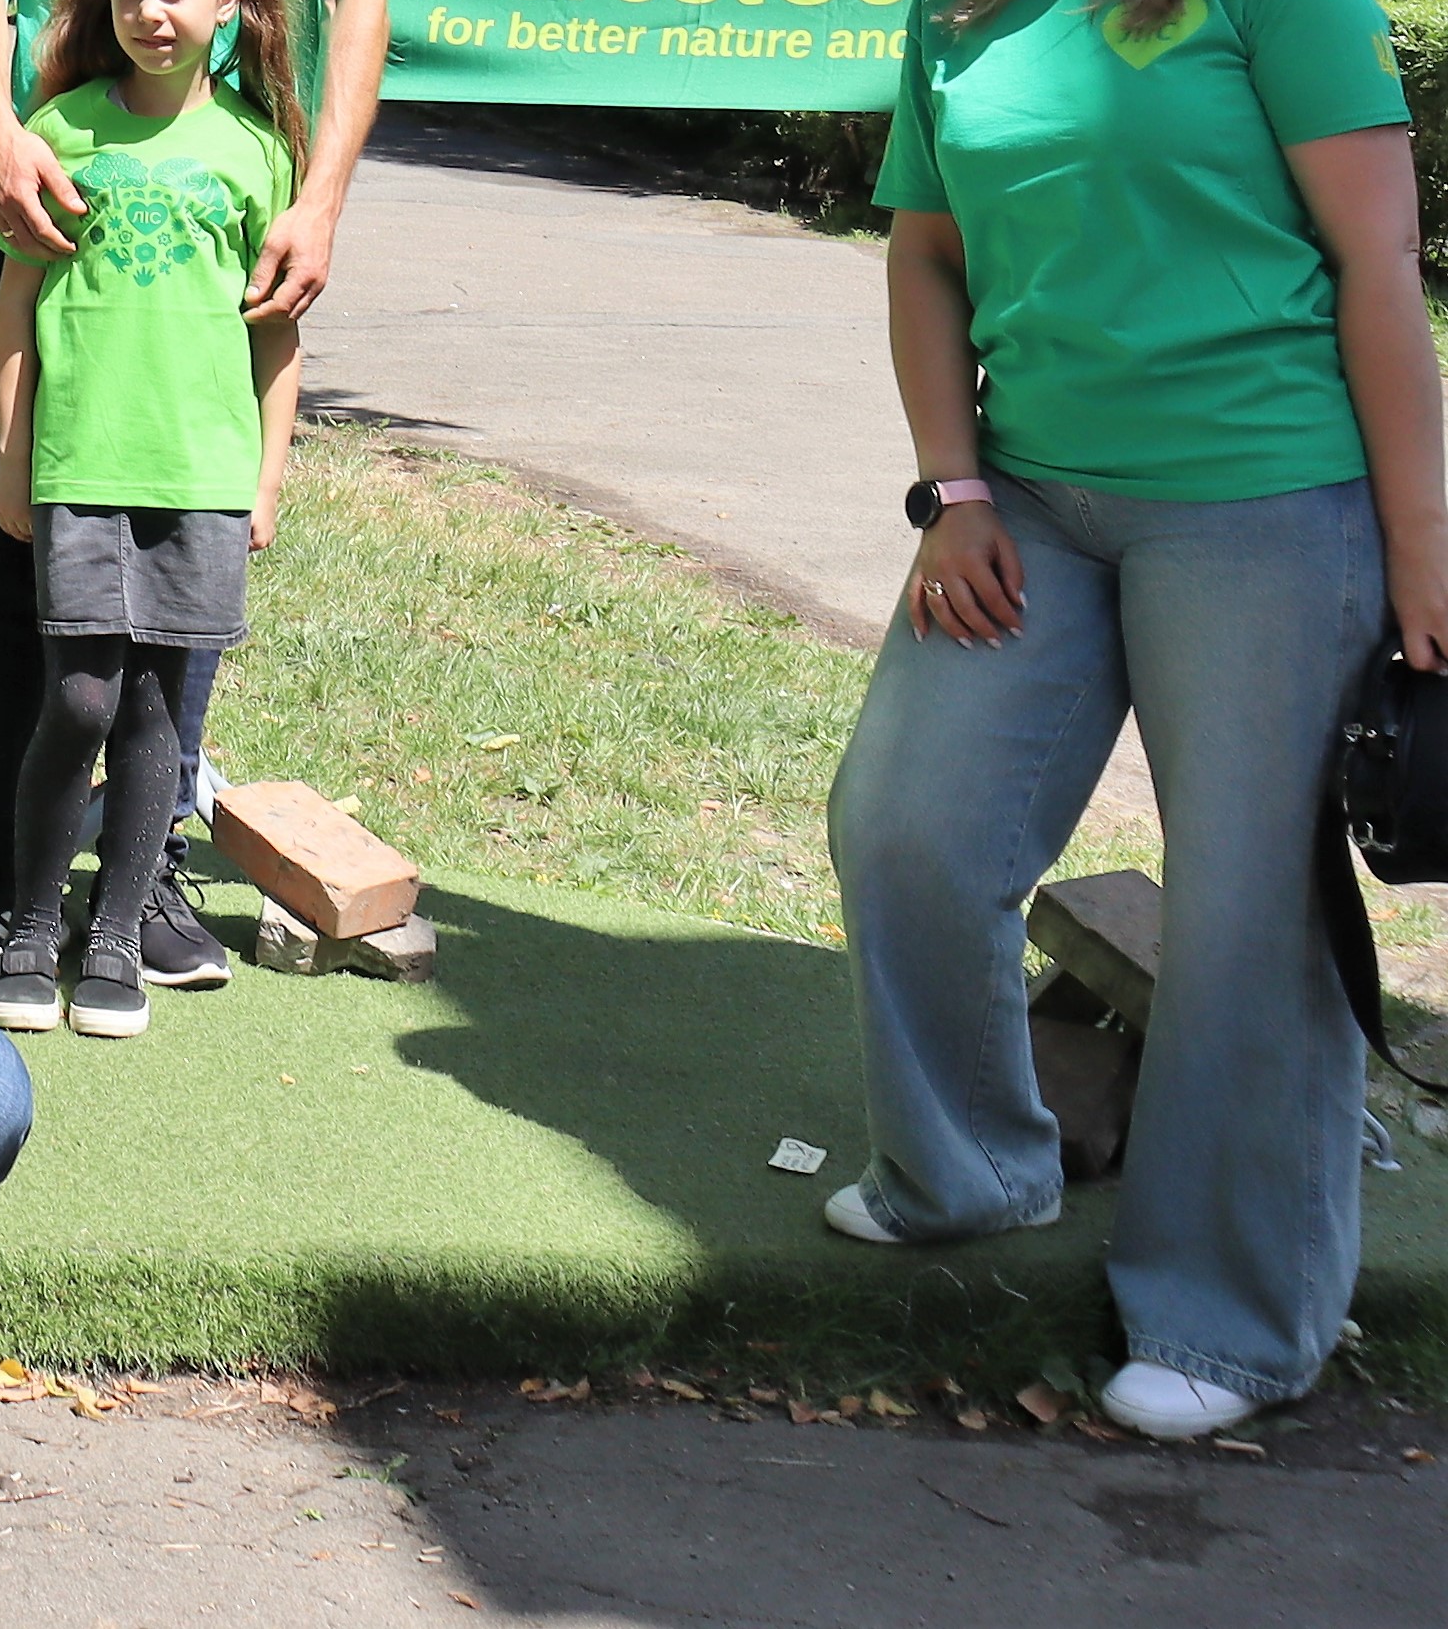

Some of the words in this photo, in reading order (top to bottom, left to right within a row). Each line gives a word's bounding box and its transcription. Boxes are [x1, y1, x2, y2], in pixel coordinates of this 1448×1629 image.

[428, 6, 494, 47] for
[508, 11, 647, 54] better
[660, 22, 812, 60] nature
[131, 211, 161, 224] ЛІС
